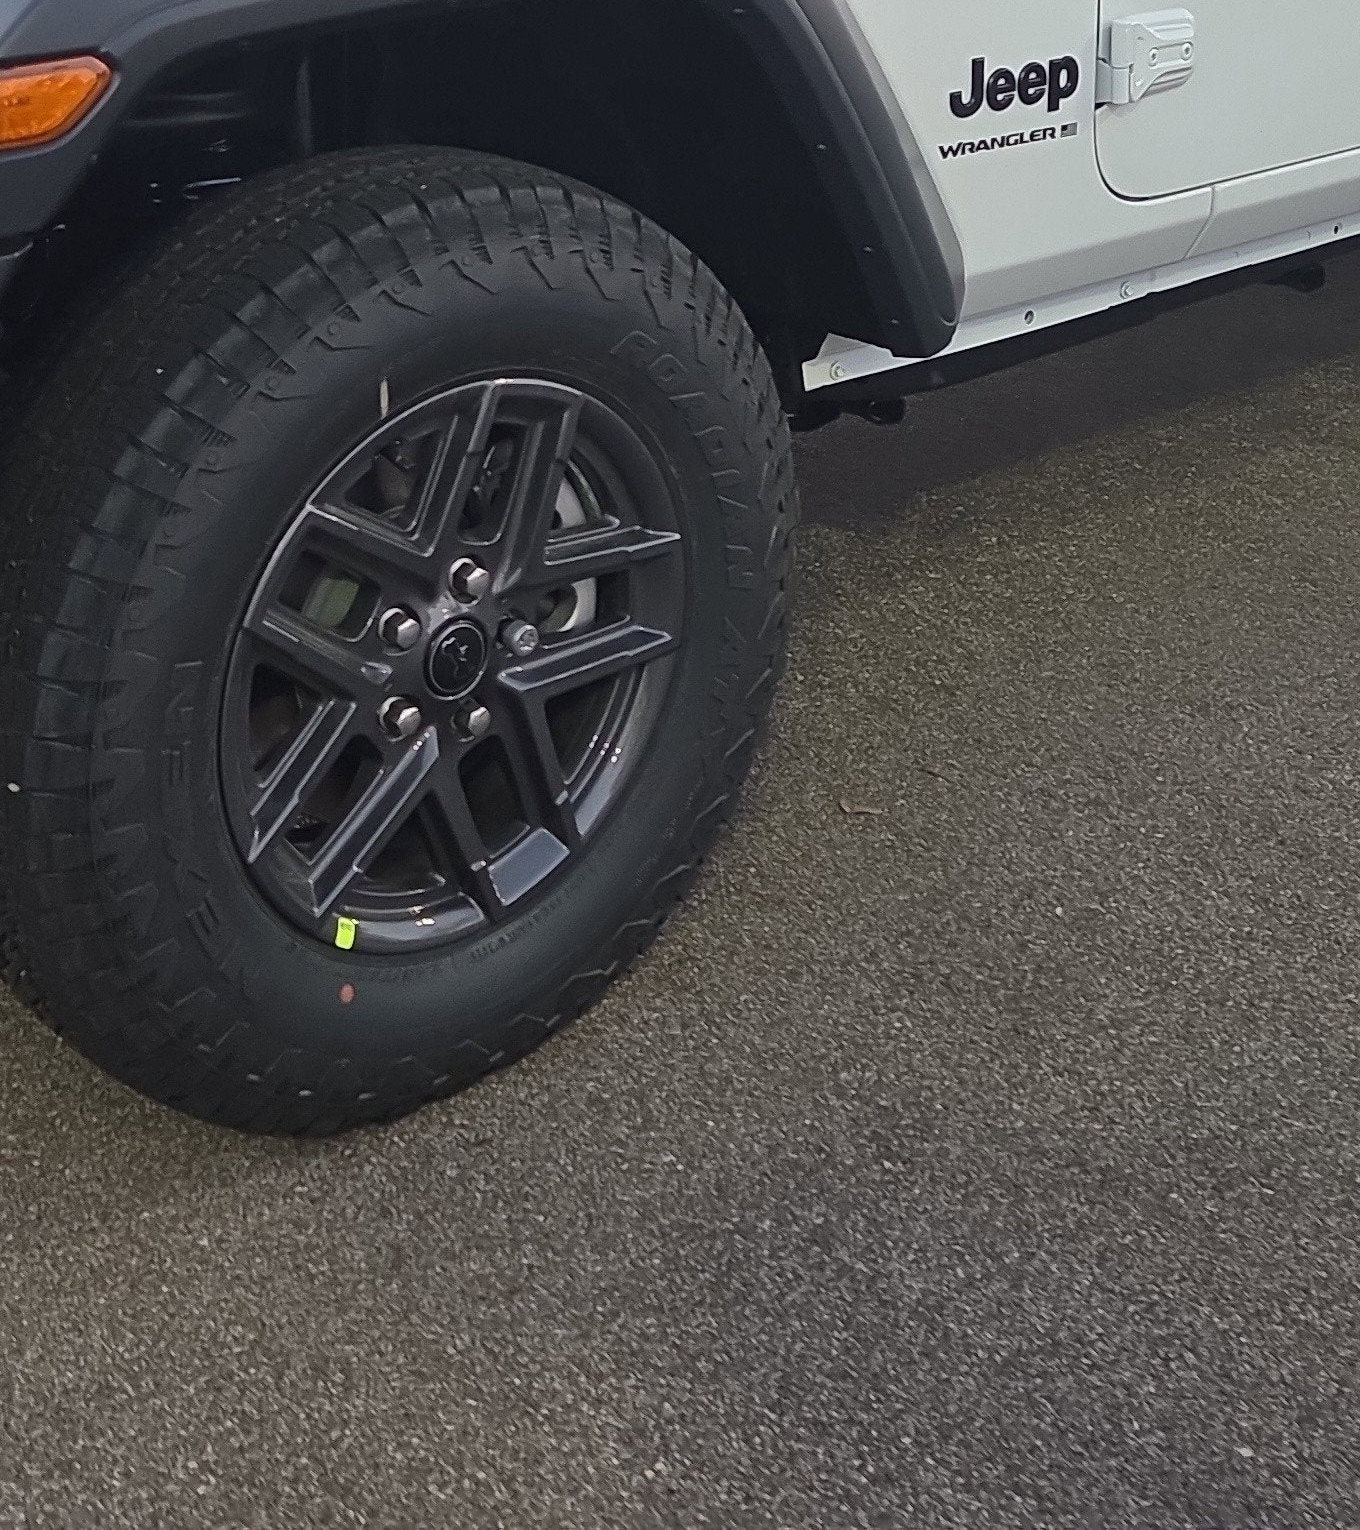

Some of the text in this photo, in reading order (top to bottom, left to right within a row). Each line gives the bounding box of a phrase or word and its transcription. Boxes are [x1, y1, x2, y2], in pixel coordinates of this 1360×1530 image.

[949, 55, 1079, 118] Jeep
[938, 125, 1056, 160] WRANGLER
[610, 329, 752, 591] ROADIAN
